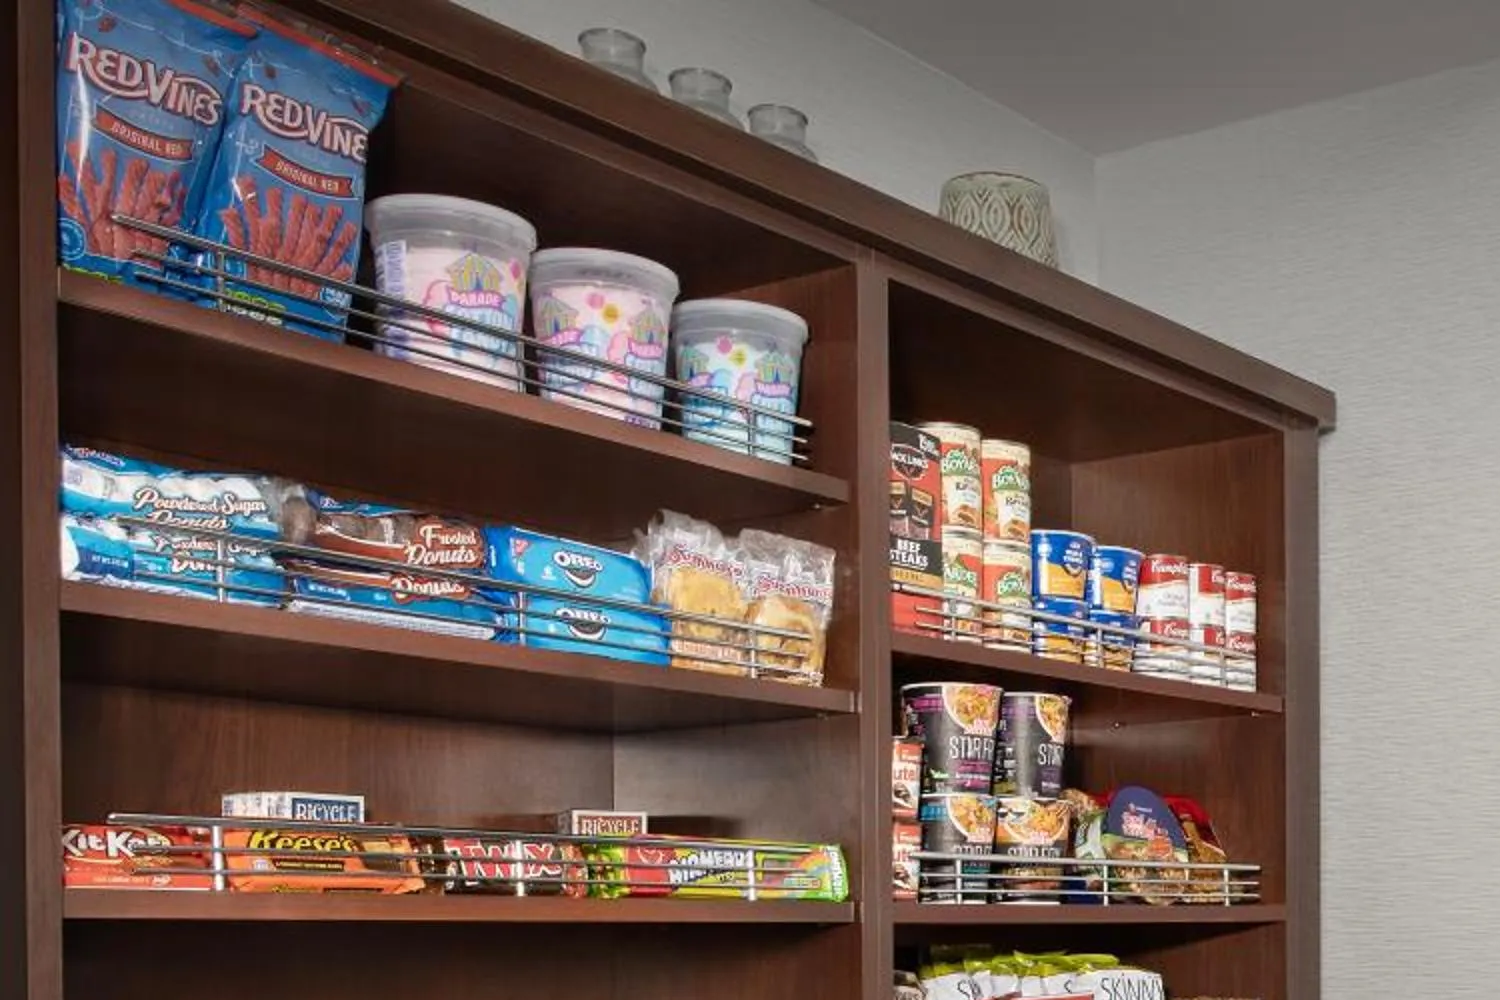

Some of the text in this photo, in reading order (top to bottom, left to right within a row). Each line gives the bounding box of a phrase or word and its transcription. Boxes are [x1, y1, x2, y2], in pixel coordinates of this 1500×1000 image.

[404, 544, 477, 566] Donuts
[554, 551, 604, 573] OREO
[294, 801, 358, 821] BICYCLE
